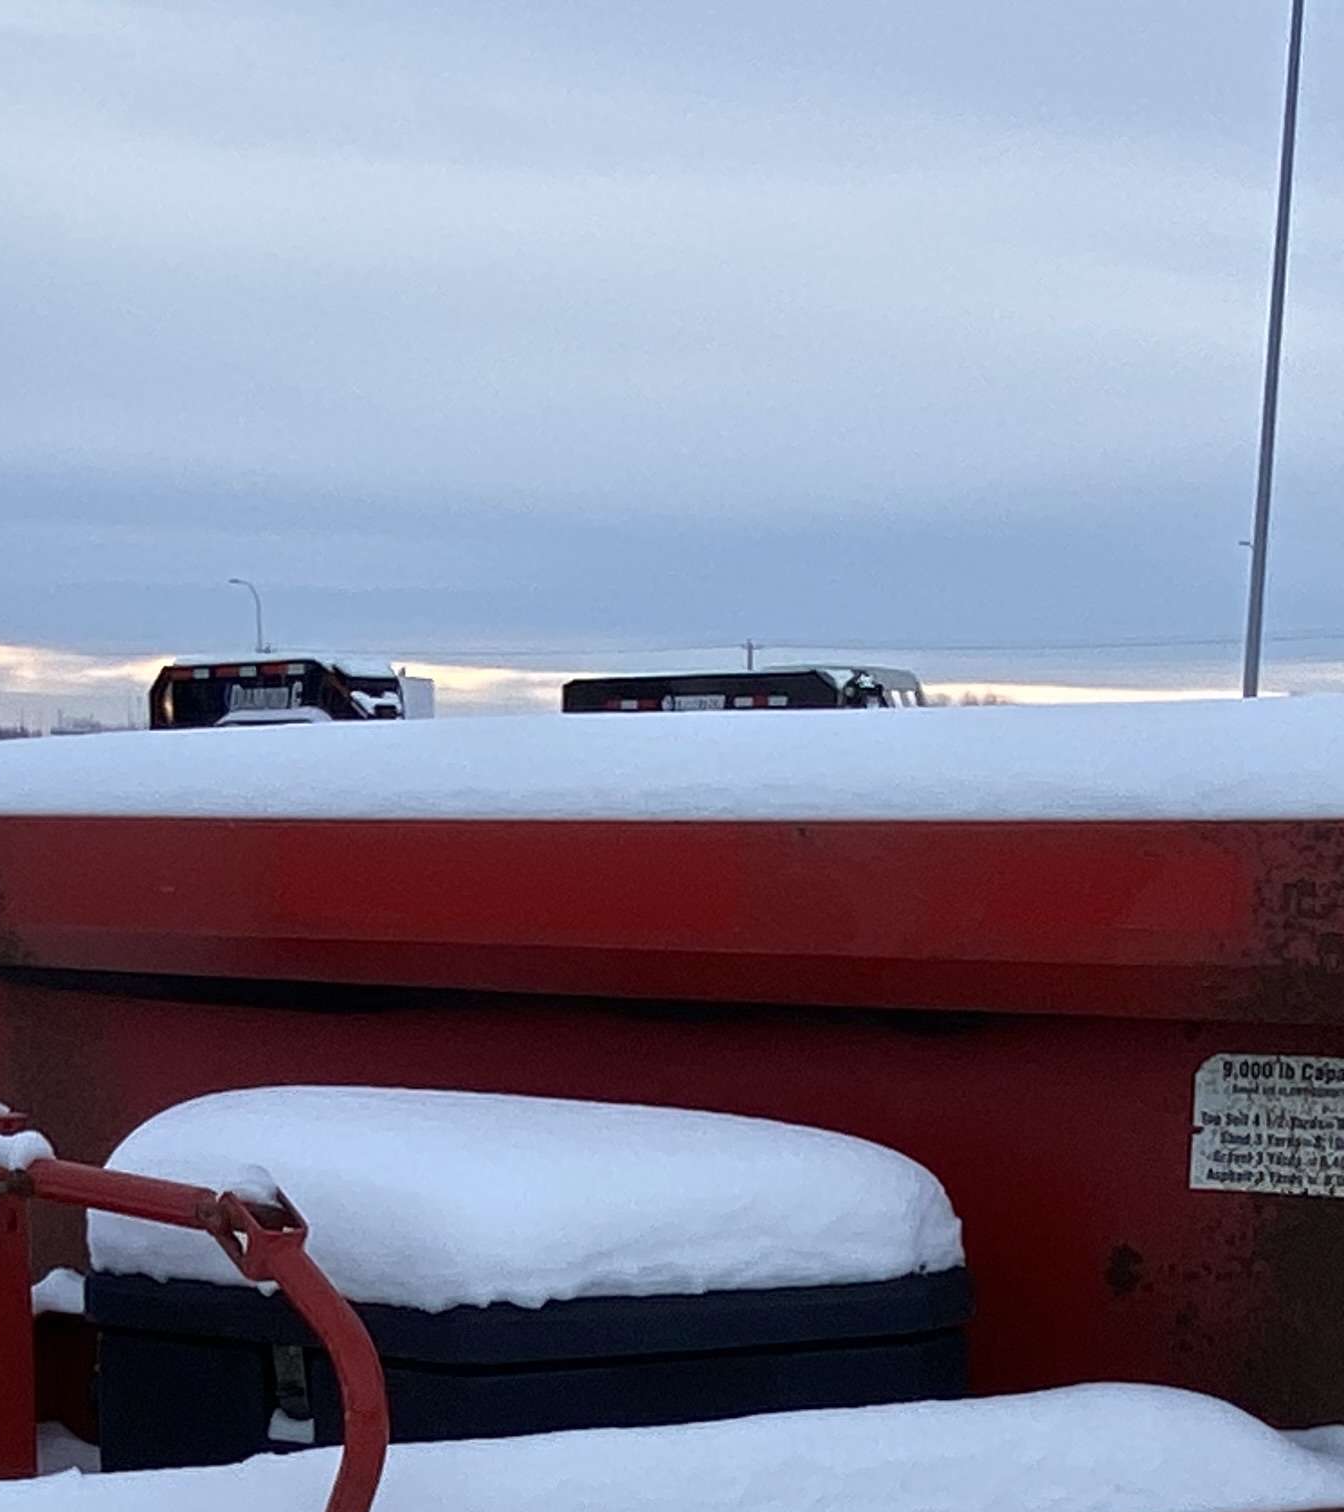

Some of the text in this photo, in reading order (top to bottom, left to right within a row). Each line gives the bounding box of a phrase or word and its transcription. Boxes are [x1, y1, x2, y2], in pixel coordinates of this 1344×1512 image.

[1278, 1062, 1296, 1079] lb
[1226, 1109, 1249, 1127] Soil
[1219, 1130, 1251, 1146] Sand
